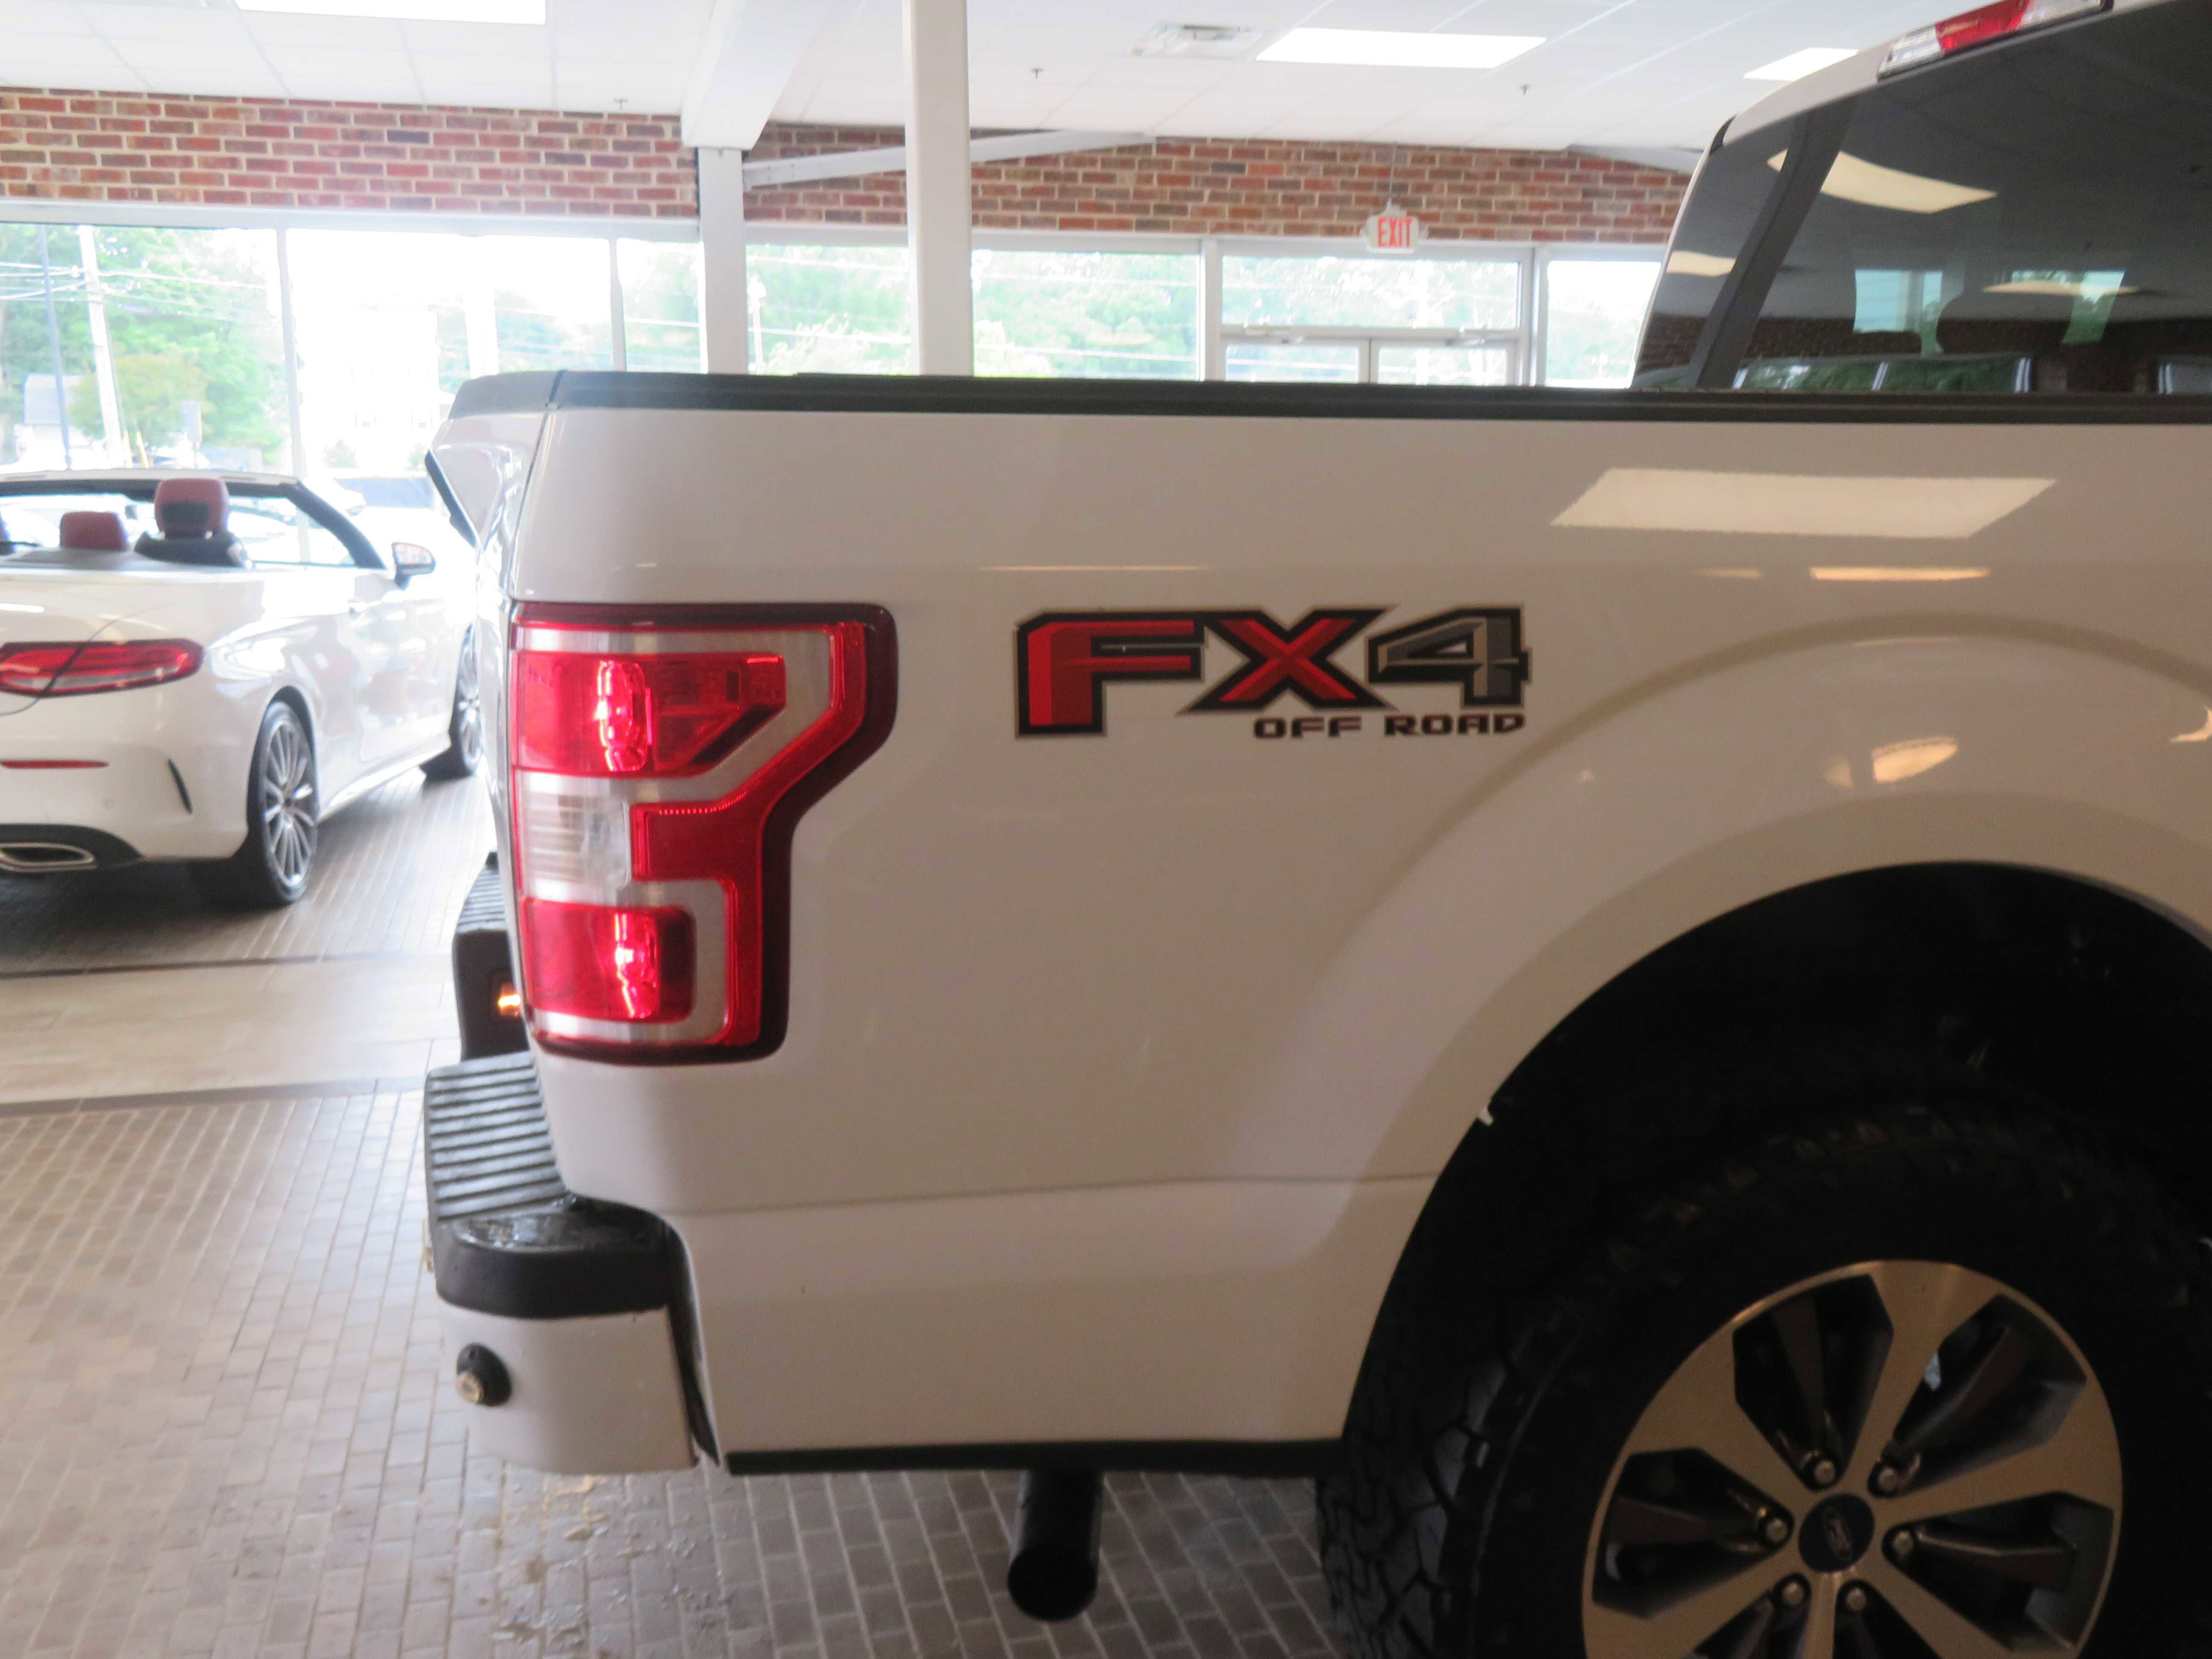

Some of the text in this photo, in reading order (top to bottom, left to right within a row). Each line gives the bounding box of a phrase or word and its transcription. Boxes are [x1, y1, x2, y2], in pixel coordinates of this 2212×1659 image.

[1378, 216, 1413, 247] EXIT
[1016, 608, 1528, 736] FX4
[1254, 714, 1525, 739] OFF ROAD
